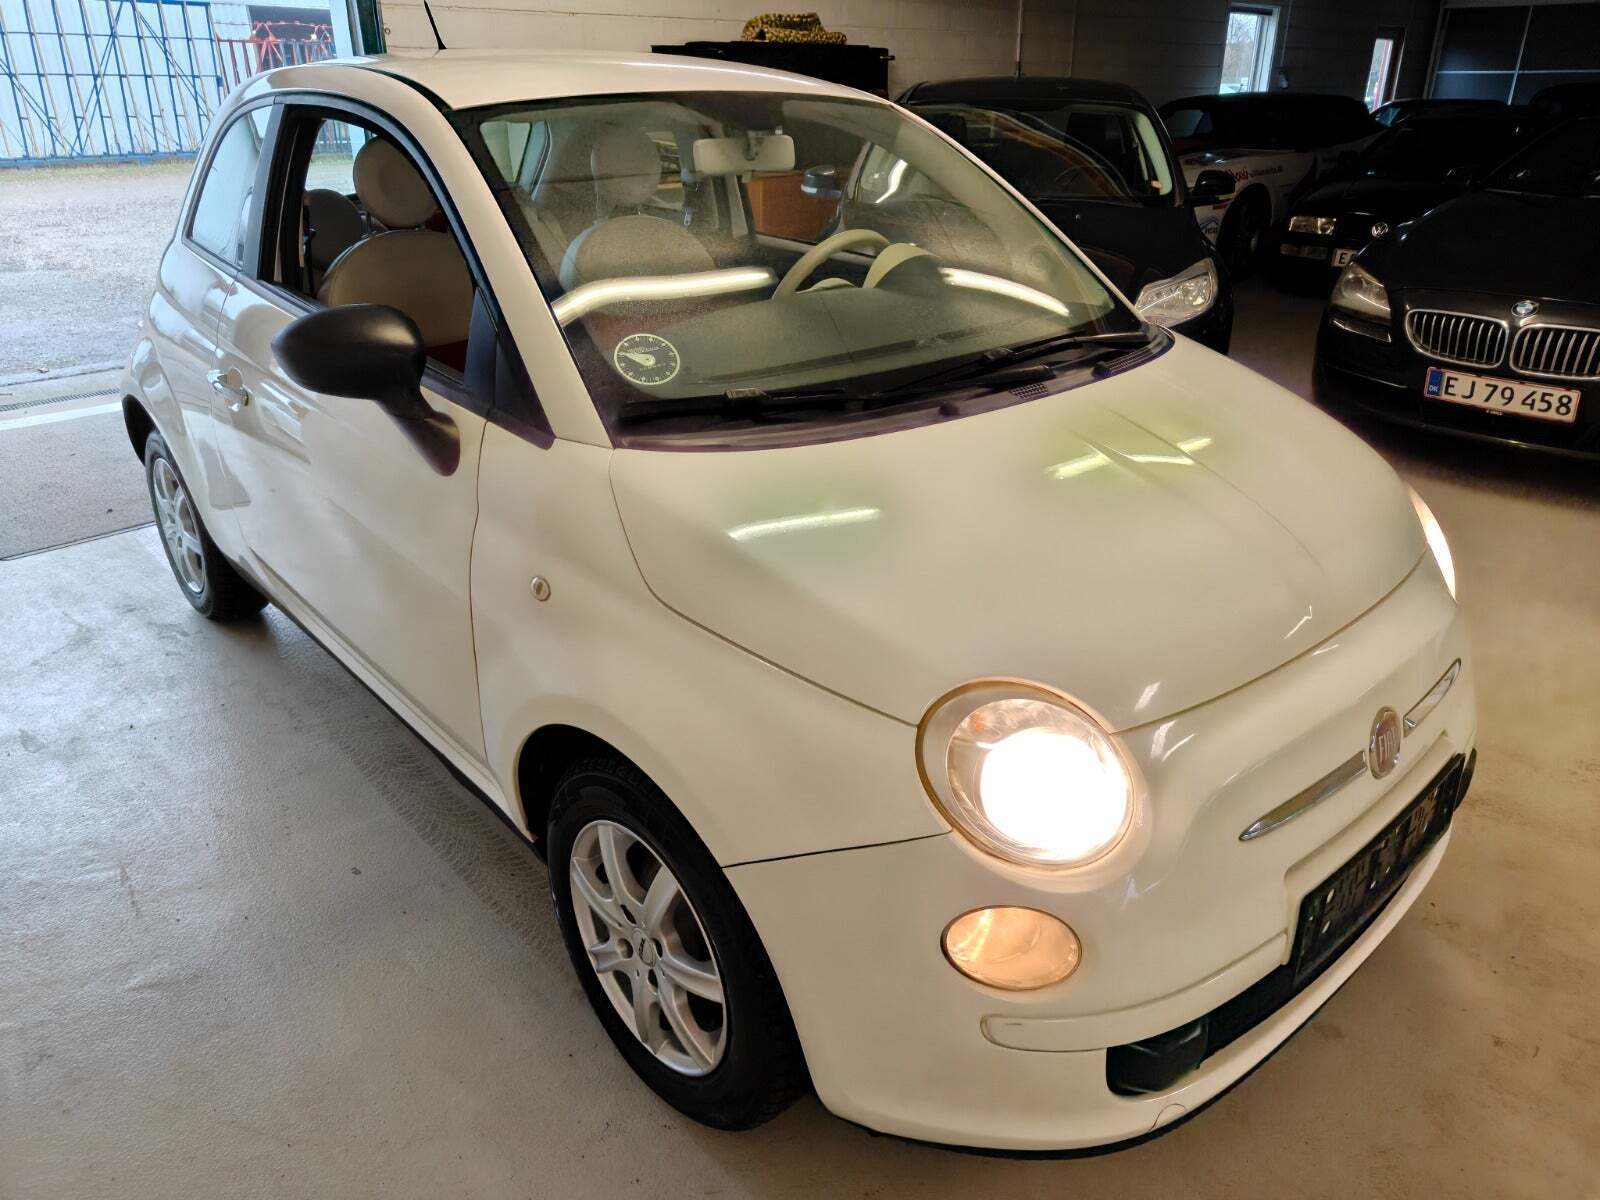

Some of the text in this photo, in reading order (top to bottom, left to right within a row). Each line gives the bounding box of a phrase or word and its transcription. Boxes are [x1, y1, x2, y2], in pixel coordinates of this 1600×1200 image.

[1443, 376, 1572, 416] EJ 79 458
